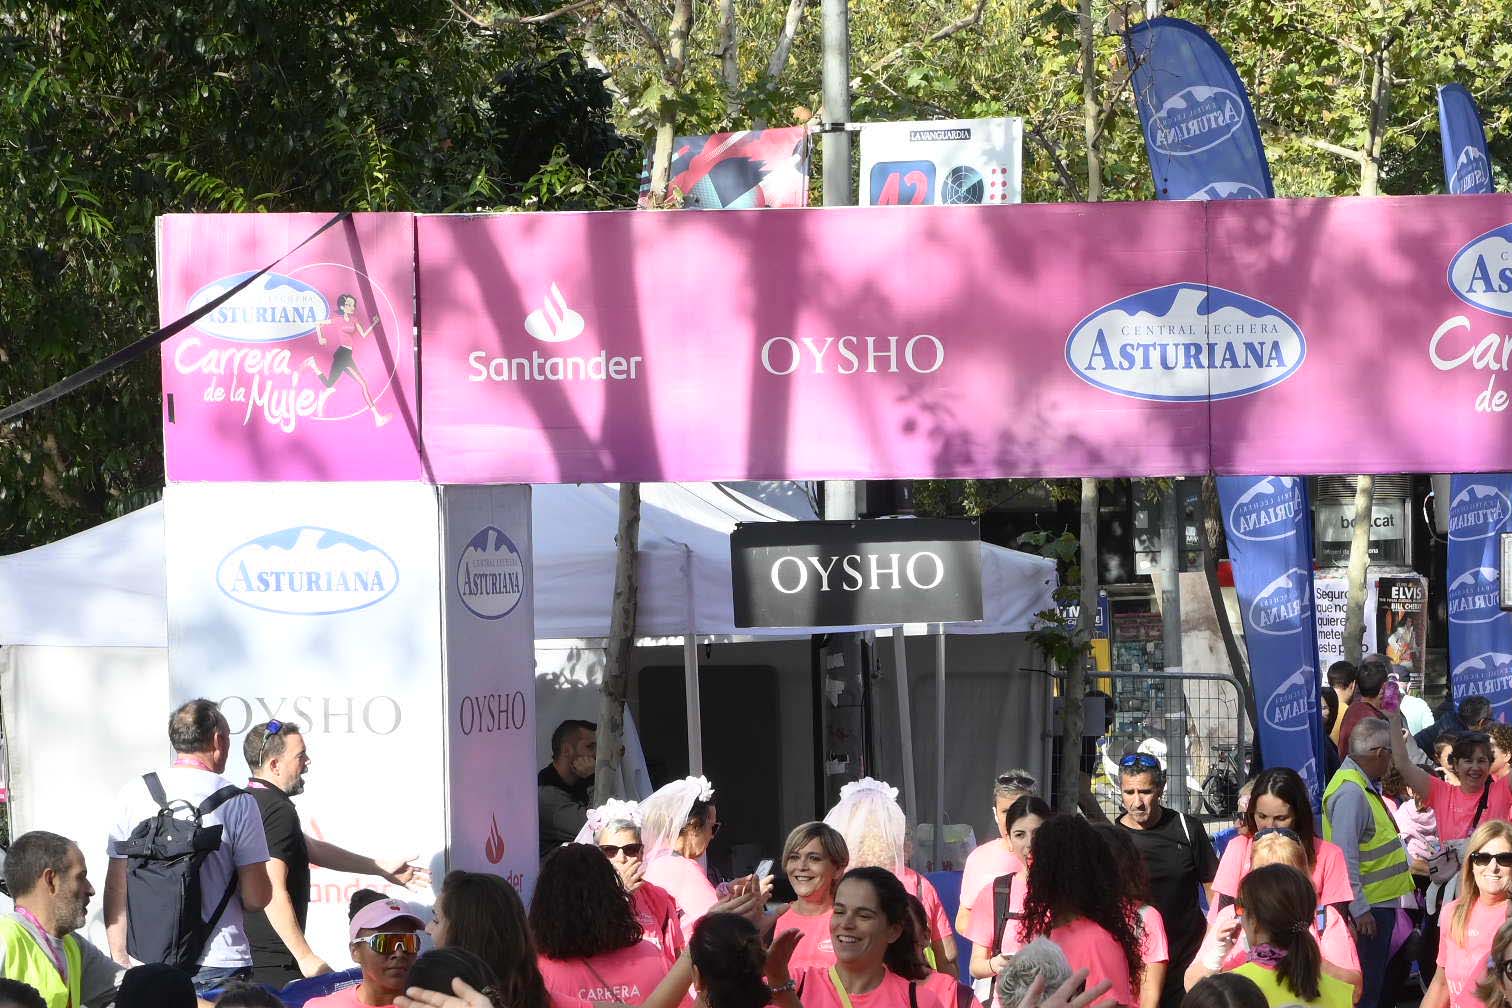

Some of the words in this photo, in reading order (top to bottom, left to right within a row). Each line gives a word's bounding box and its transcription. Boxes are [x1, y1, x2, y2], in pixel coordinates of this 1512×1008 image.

[1121, 324, 1196, 335] CENTRAL
[1204, 323, 1281, 335] LECHERA
[174, 337, 293, 375] Carrera
[468, 349, 642, 382] Santander
[761, 334, 945, 376] OYSHO
[1084, 328, 1287, 371] ASTURIANA
[203, 380, 226, 402] de
[230, 376, 246, 402] la
[243, 371, 336, 433] Mujer
[1474, 374, 1510, 412] de
[231, 560, 385, 592] ASTURIANA
[462, 554, 521, 596] ASTURIANA
[771, 551, 944, 594] OYSHO
[1316, 604, 1332, 617] que
[1391, 586, 1422, 599] ELVIS
[1317, 615, 1347, 627] quiere
[1319, 643, 1336, 653] este
[220, 696, 401, 735] OYSHO
[460, 690, 525, 735] OYSHO
